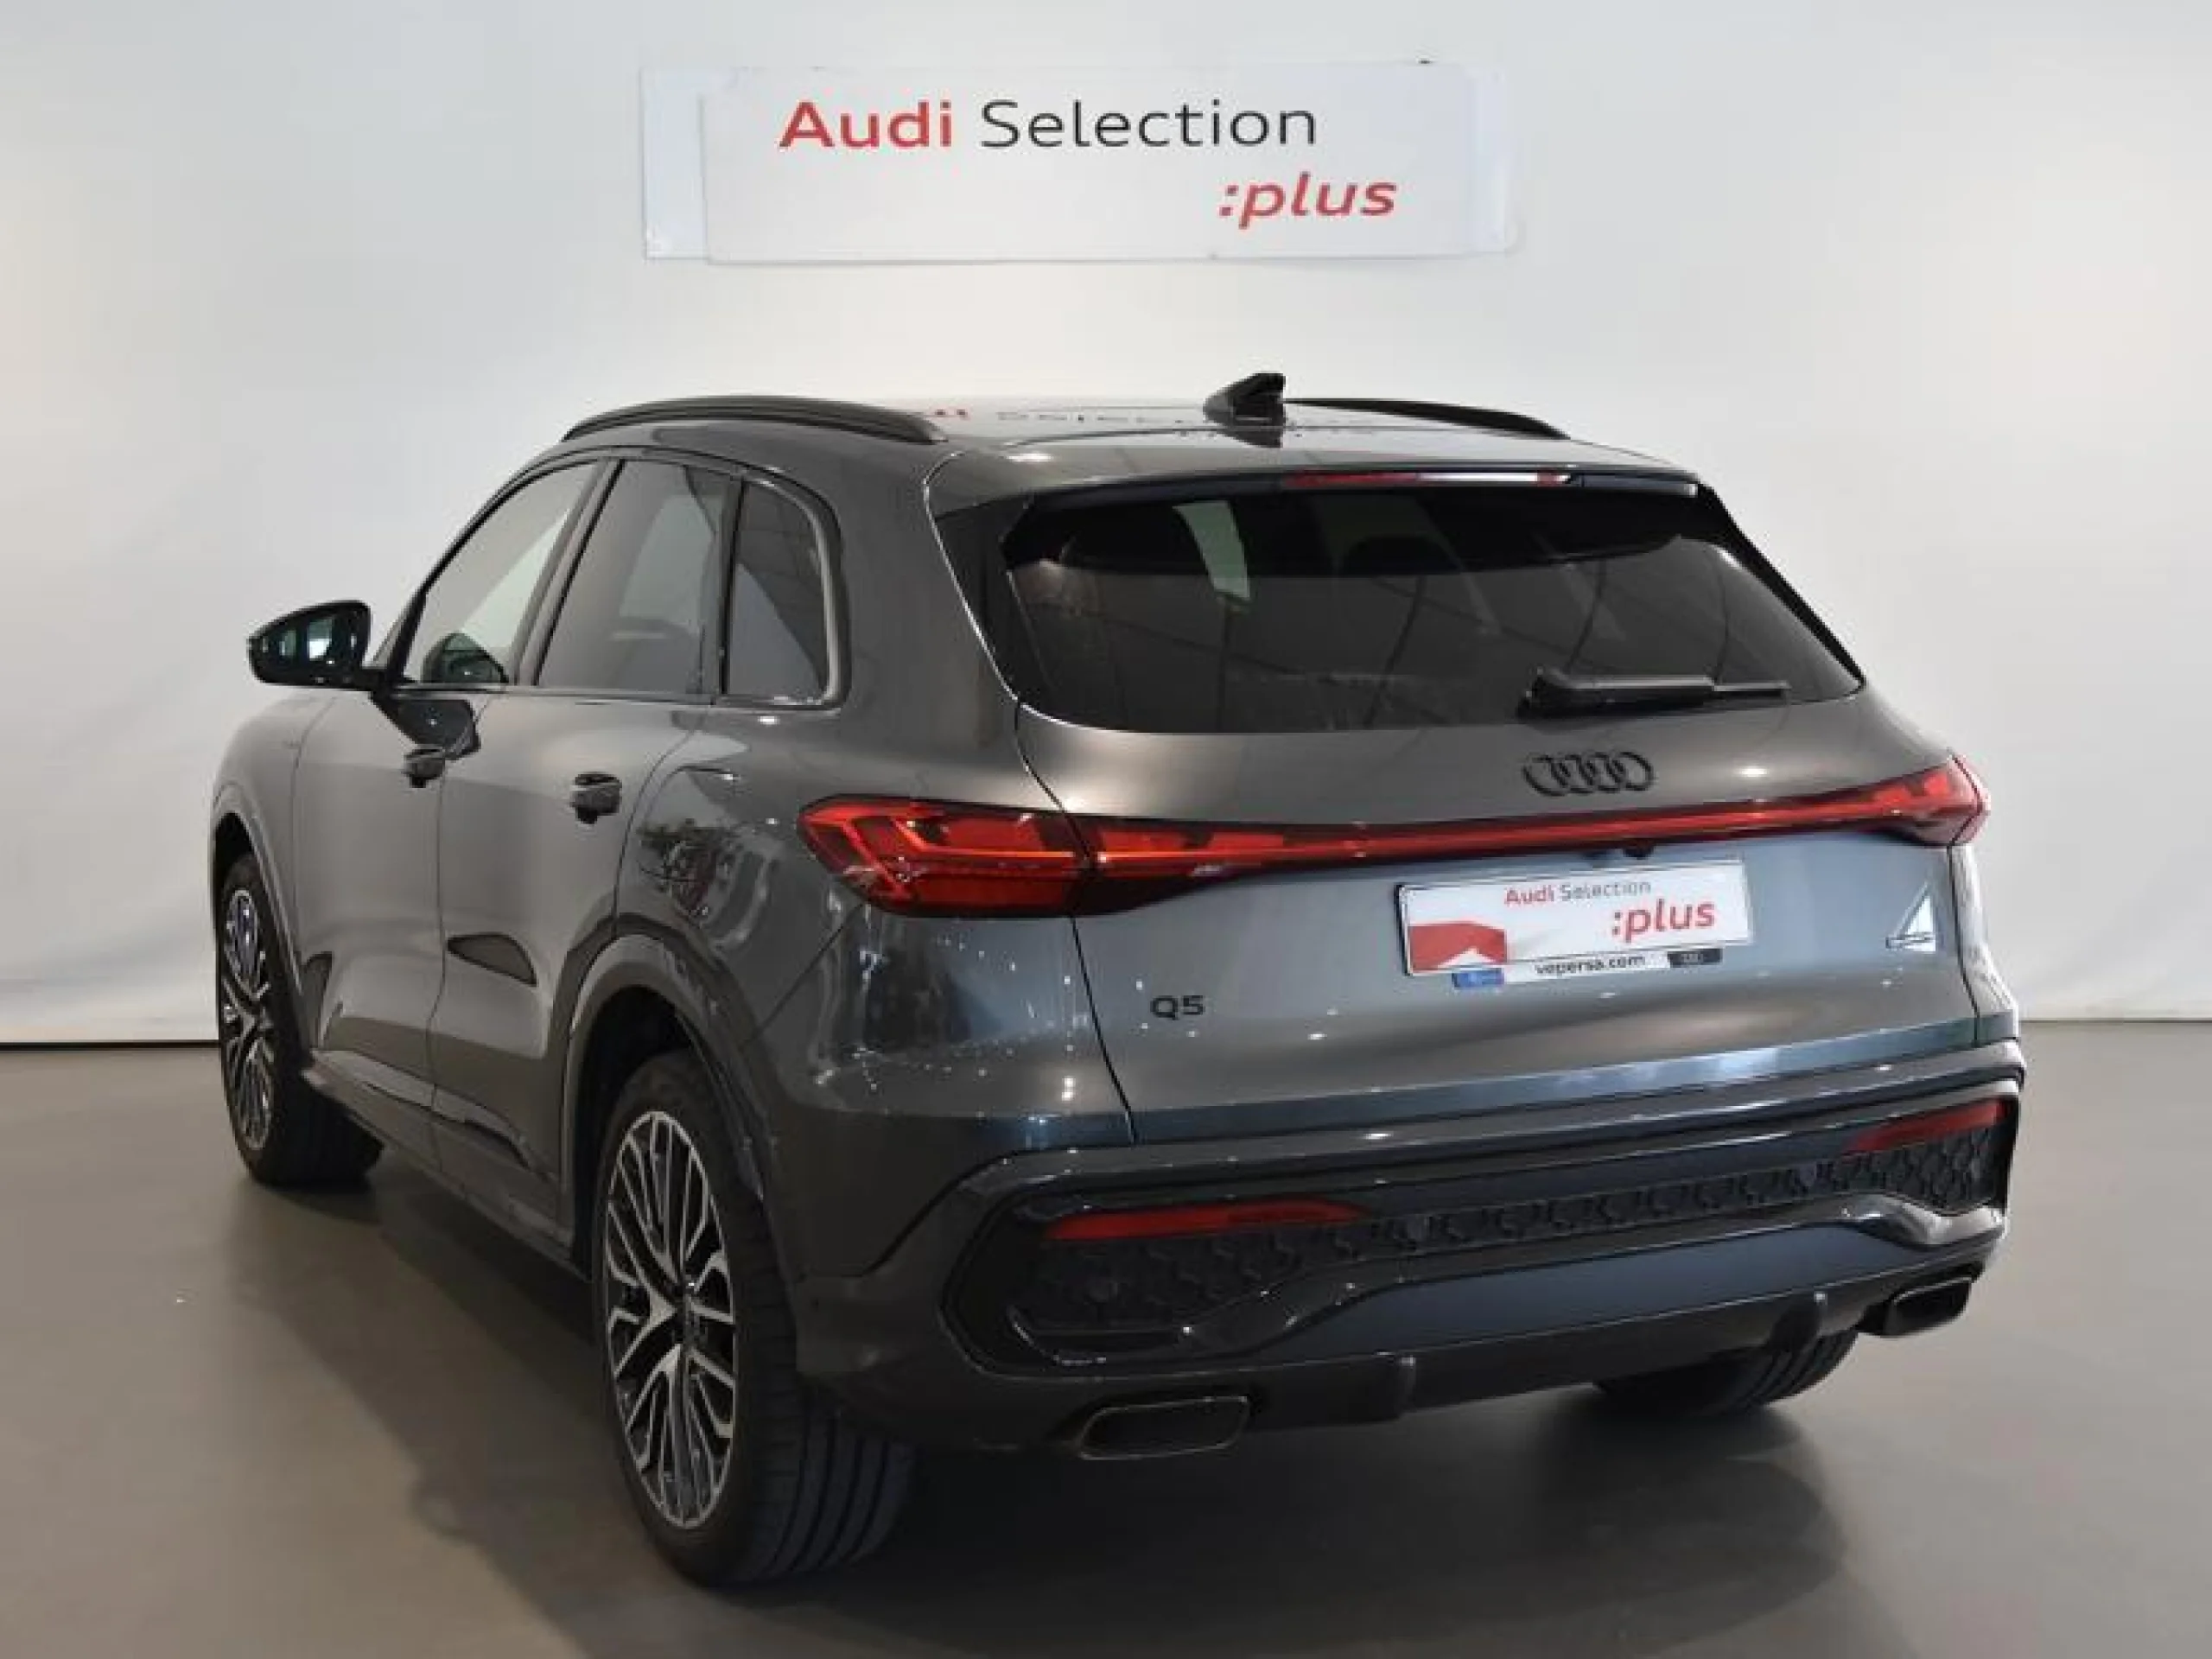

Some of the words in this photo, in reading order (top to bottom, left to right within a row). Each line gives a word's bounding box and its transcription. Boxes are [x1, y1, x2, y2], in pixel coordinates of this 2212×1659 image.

[779, 100, 952, 149] Audi
[981, 99, 1316, 148] Selection
[1218, 171, 1398, 229] :plus
[1505, 885, 1554, 905] Audi
[1559, 880, 1651, 902] Selection
[1611, 899, 1715, 943] :plus
[1150, 995, 1205, 1020] Q5
